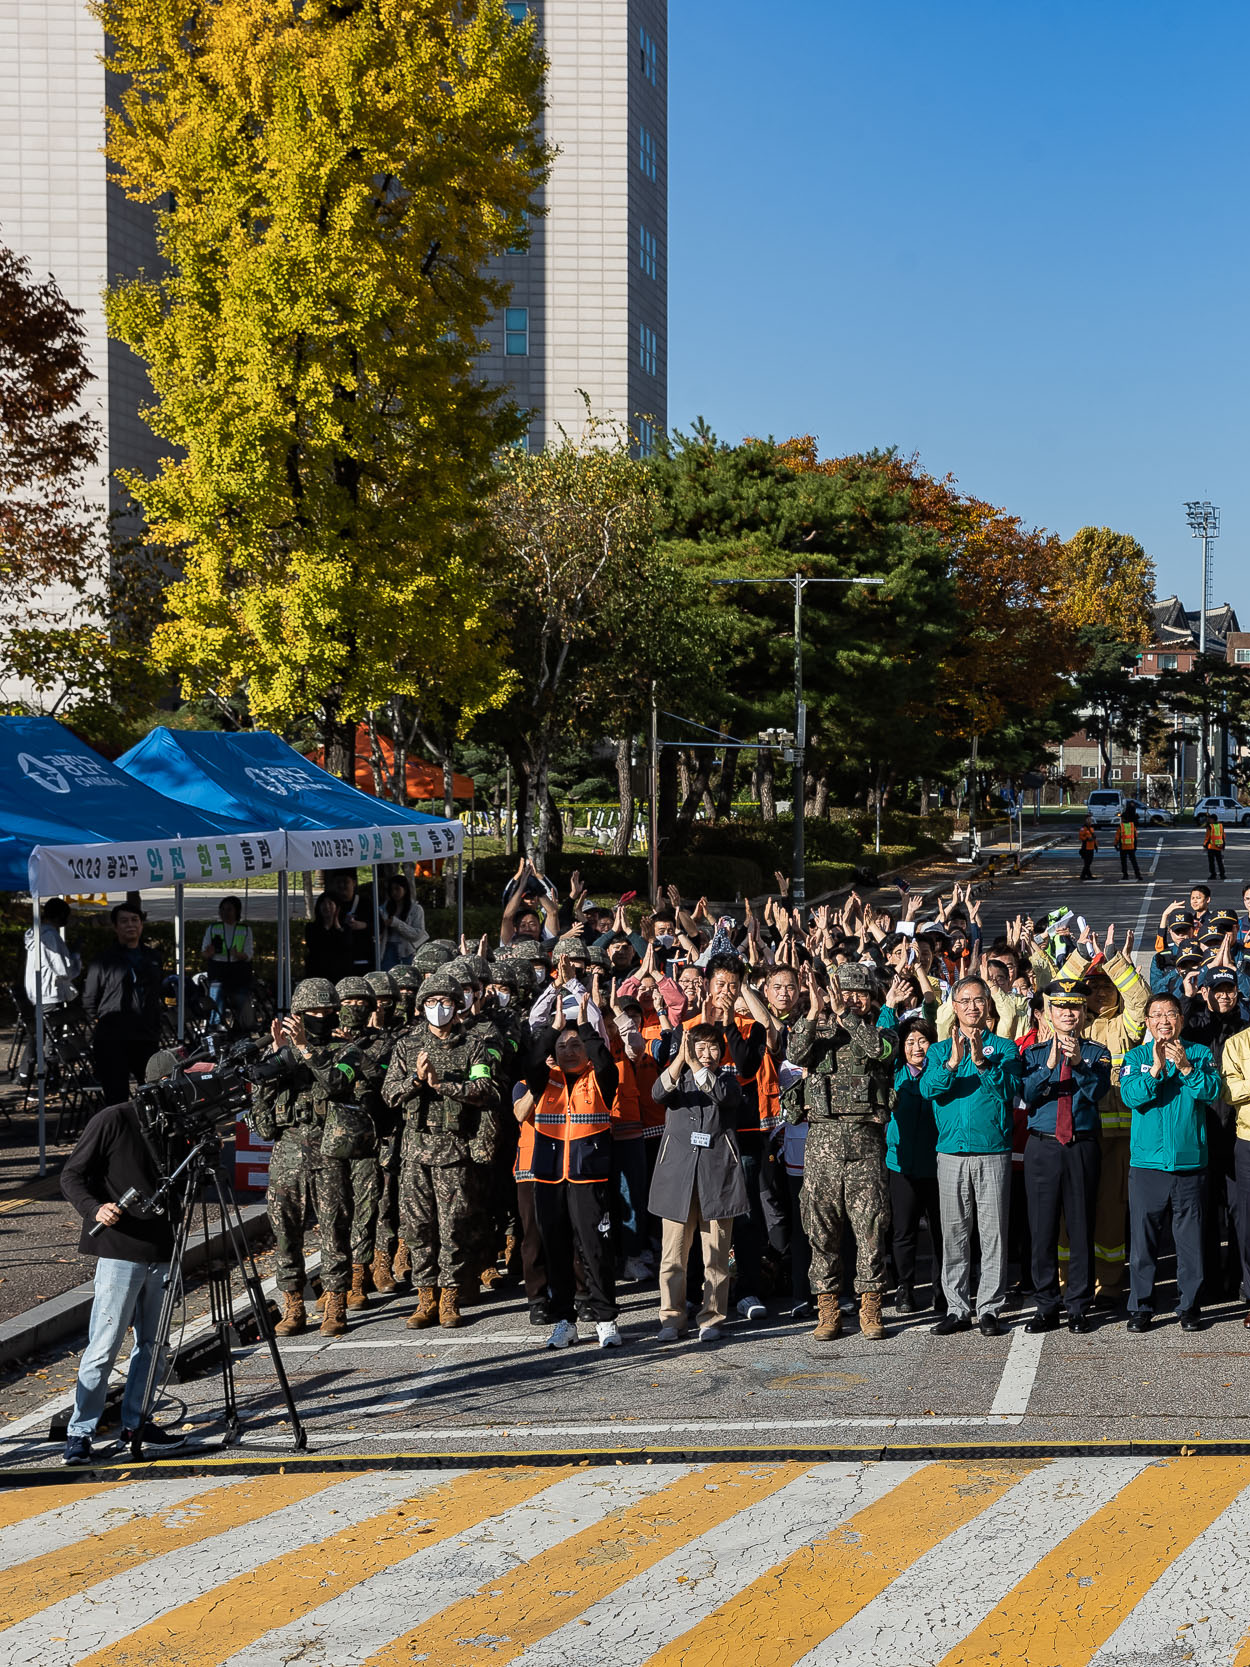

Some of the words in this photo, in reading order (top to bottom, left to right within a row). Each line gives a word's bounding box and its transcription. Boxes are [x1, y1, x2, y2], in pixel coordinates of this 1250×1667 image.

[43, 754, 109, 776] 광진구
[311, 840, 333, 858] 2023
[333, 838, 355, 858] 광진구
[358, 833, 383, 861] 안전
[391, 831, 422, 858] 한국
[427, 827, 456, 854] 훈련
[67, 858, 101, 880] 2023
[106, 854, 139, 880] 광진구
[146, 846, 187, 883] 안전
[196, 843, 232, 878] 한국
[239, 838, 273, 872] 훈련
[1213, 972, 1234, 980] POLICE
